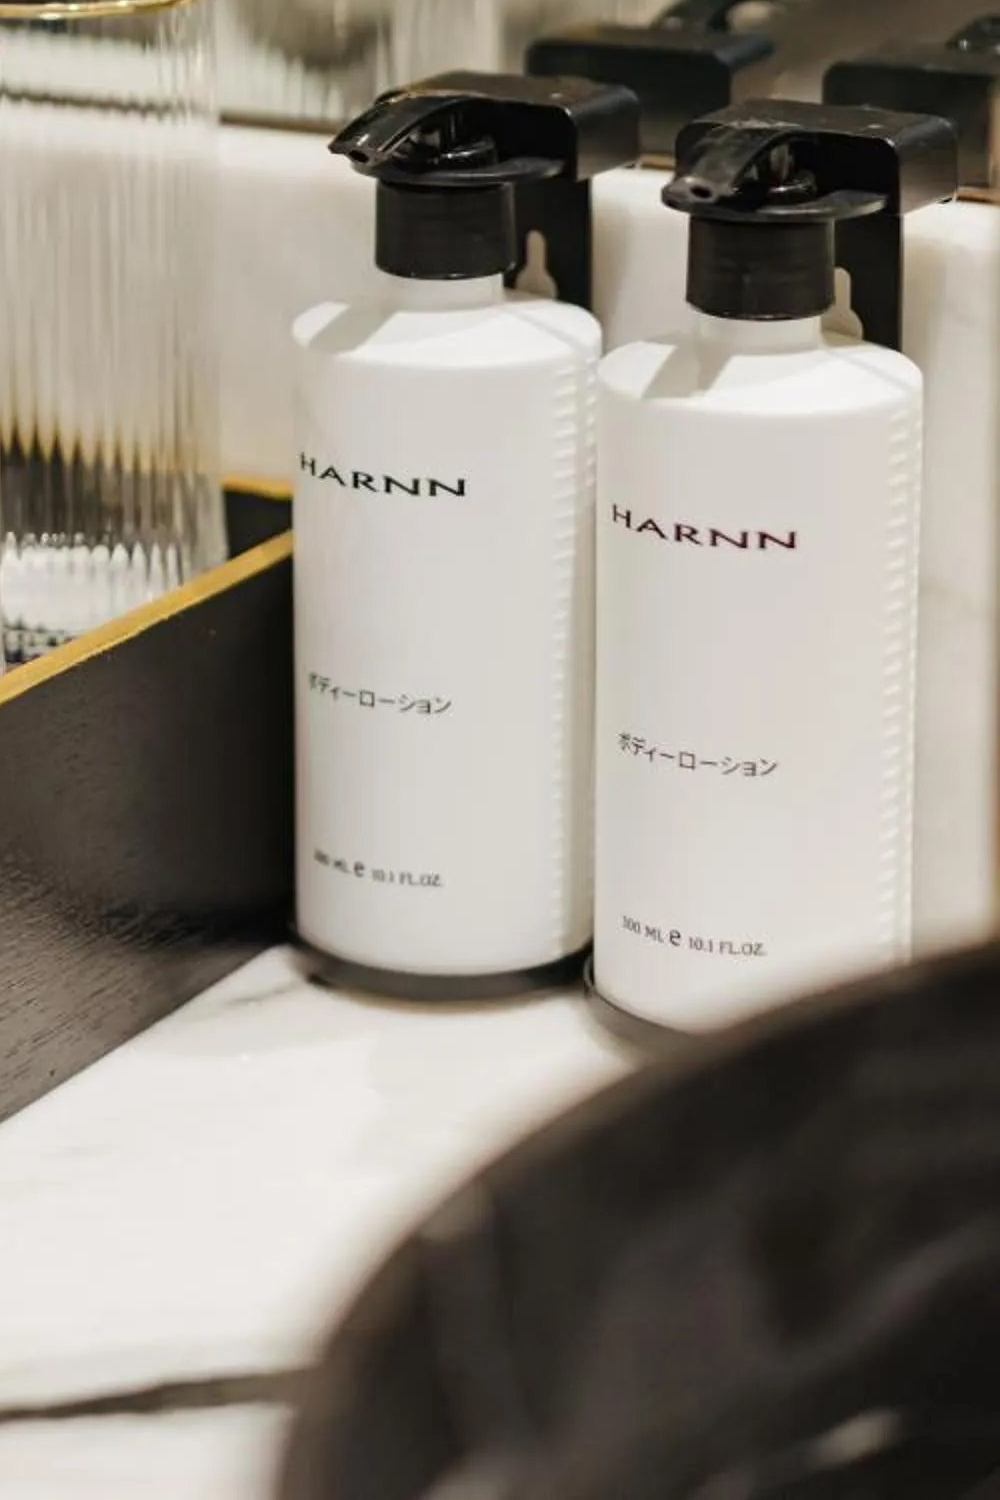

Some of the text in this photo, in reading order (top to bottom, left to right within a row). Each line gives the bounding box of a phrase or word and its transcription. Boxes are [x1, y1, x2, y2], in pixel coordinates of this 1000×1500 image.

[299, 451, 466, 497] HARNN
[612, 503, 797, 549] HARNN
[669, 928, 682, 947] e
